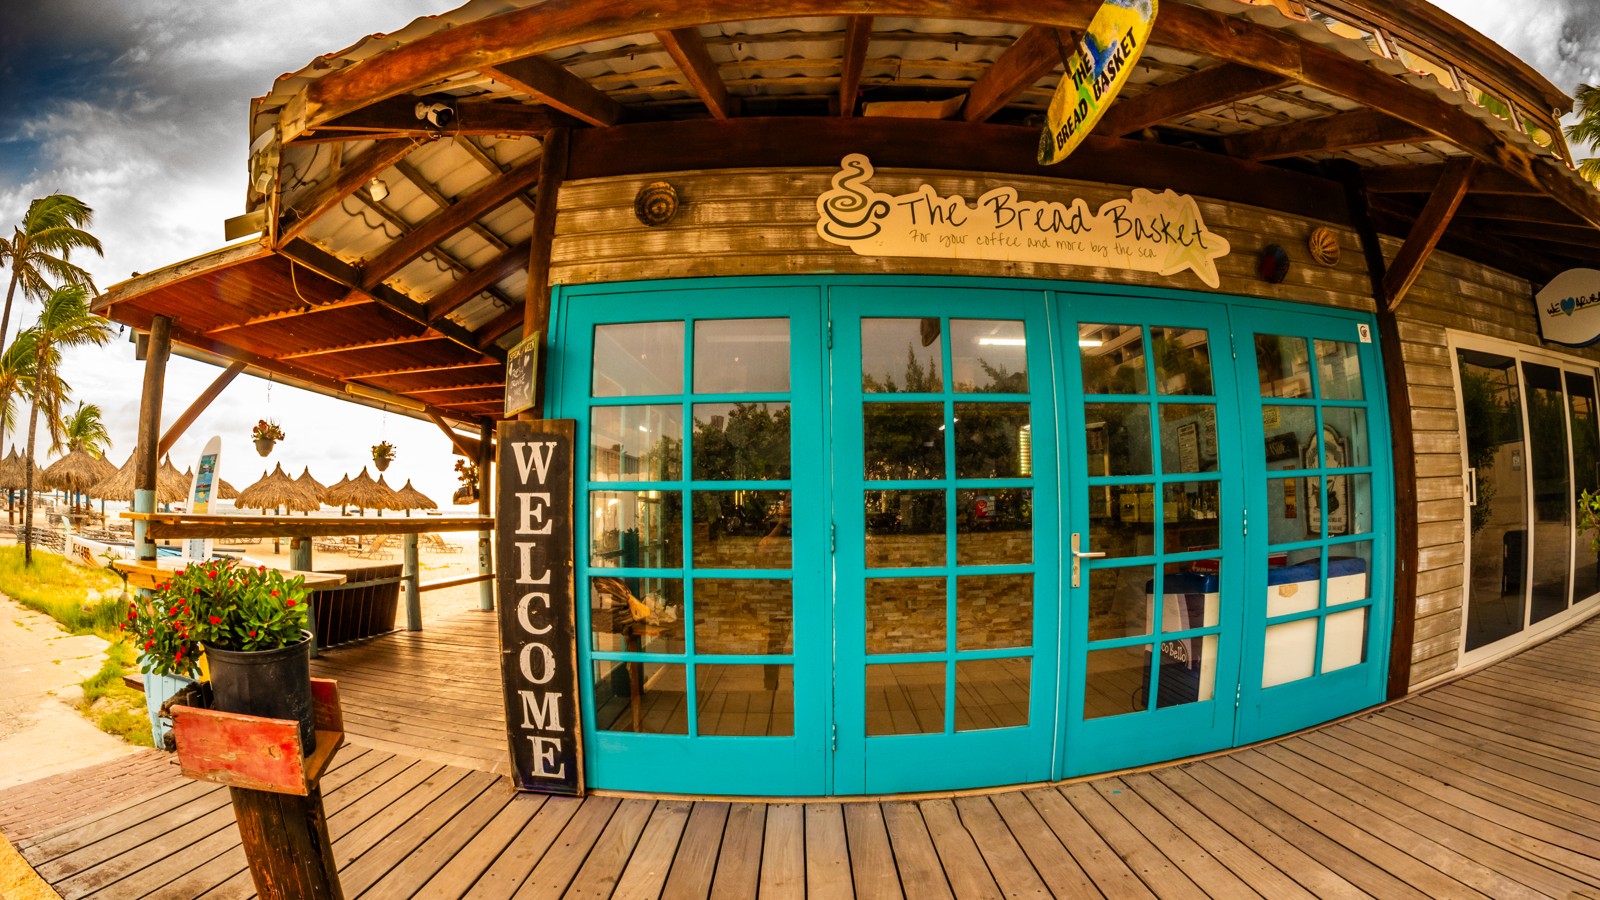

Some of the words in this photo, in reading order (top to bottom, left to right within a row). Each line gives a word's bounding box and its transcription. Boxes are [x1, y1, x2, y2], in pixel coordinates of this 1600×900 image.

[1056, 98, 1088, 151] BREAD
[1092, 27, 1137, 101] BASKET
[1071, 53, 1092, 91] THE
[897, 193, 968, 227] The
[984, 193, 1092, 234] Bread
[1103, 205, 1208, 249] Basket
[909, 229, 931, 243] For
[939, 231, 968, 248] your
[976, 232, 1021, 248] coffee
[1027, 237, 1051, 249] and
[1055, 241, 1086, 252] more
[1090, 241, 1108, 258] by
[1113, 243, 1133, 257] the
[1138, 247, 1157, 258] sea
[510, 441, 566, 780] WELCOME
